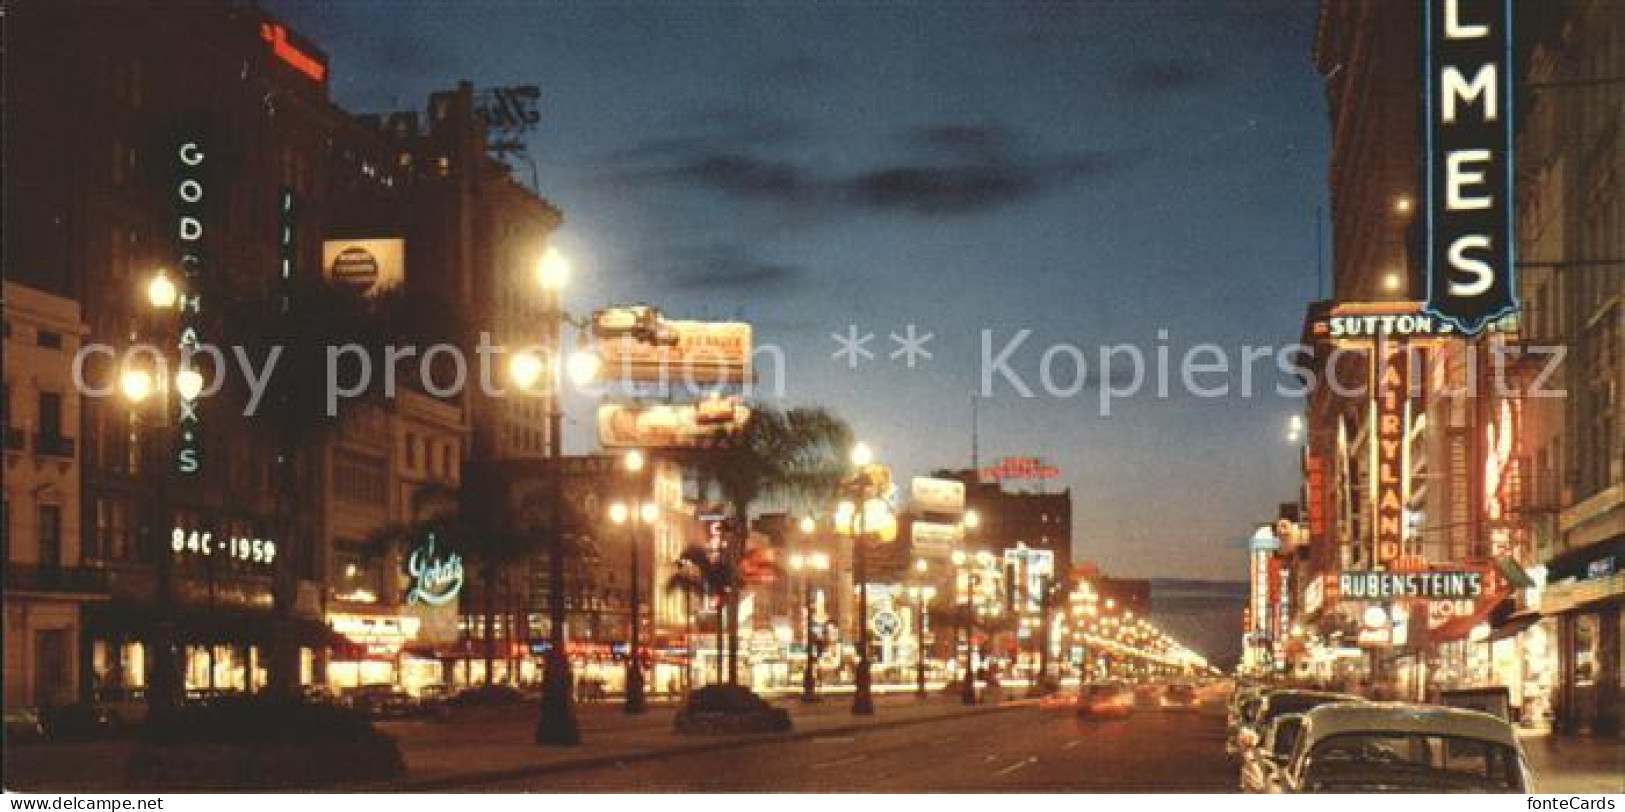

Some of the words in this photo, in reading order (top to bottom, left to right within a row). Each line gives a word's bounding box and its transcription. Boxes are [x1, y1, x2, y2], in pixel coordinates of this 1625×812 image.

[1380, 340, 1400, 561] FAIRYLAND
[230, 537, 277, 564] 1959
[1340, 572, 1482, 596] RUBENSTEIN'S
